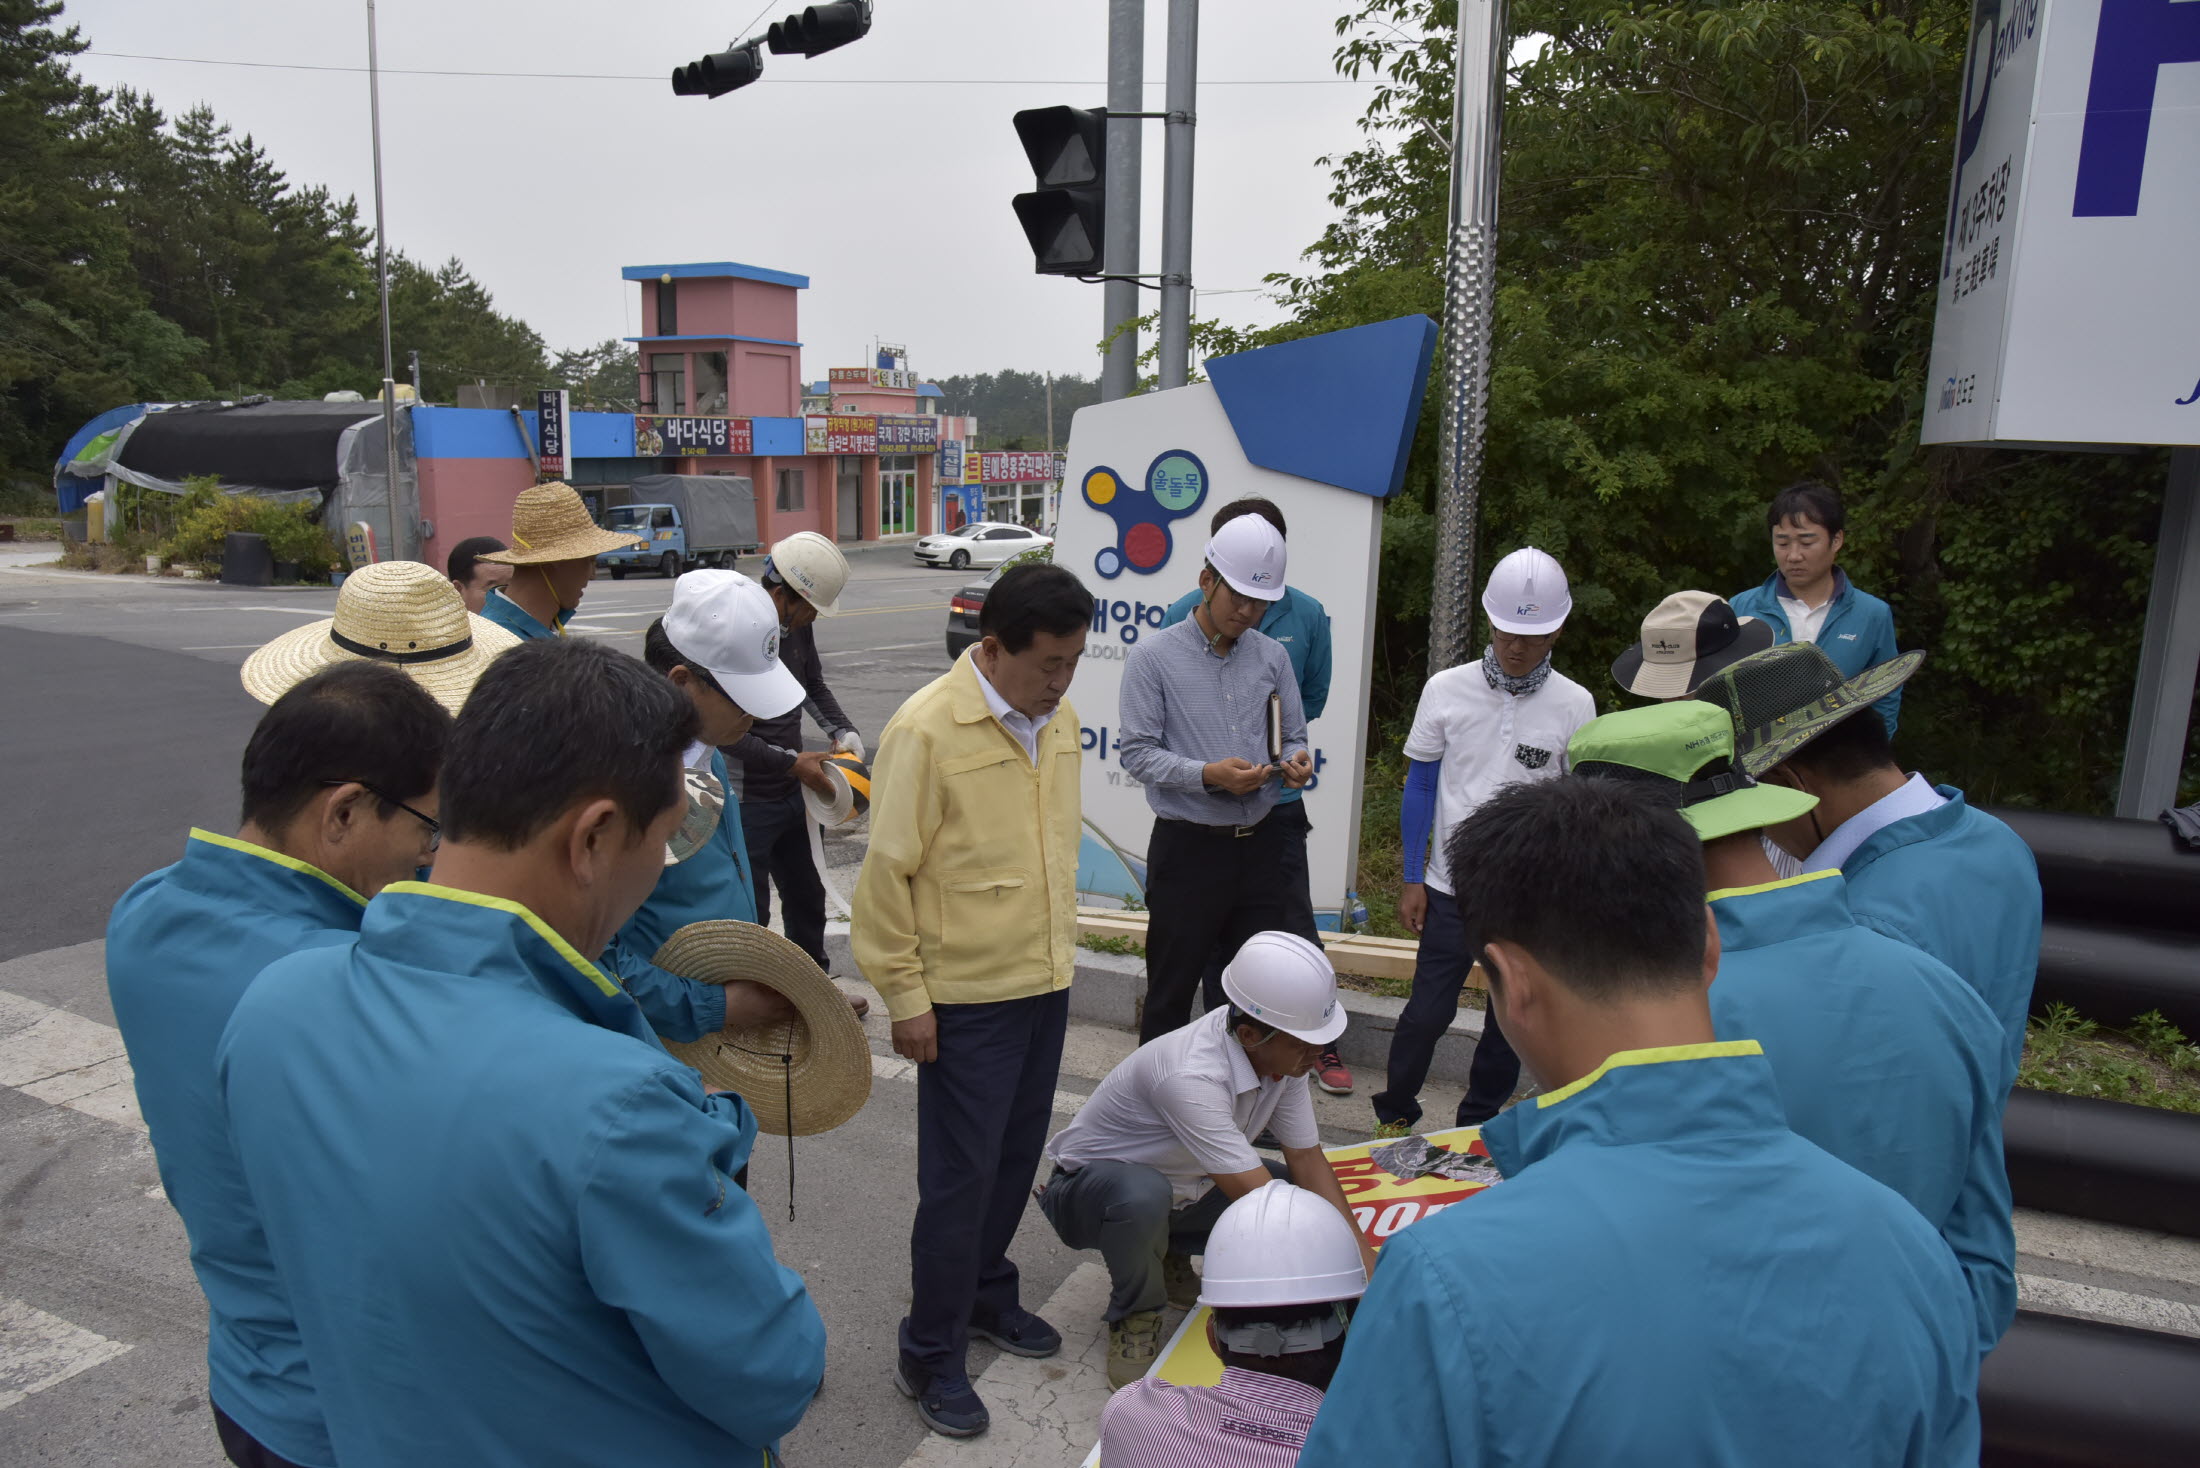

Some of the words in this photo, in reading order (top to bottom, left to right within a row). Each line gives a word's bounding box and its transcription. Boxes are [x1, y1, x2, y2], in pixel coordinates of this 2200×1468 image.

[1957, 153, 2012, 252] 제3주차장
[543, 392, 559, 455] 바다식당
[667, 418, 727, 446] 바다식당
[878, 426, 892, 443] 국제
[897, 427, 911, 443] 강판
[911, 427, 937, 444] 지붕공사
[828, 435, 849, 453] 슬라브
[850, 435, 876, 454] 지붕전문
[1153, 469, 1199, 498] 울돌목
[1223, 1418, 1236, 1430] LE
[1238, 1422, 1257, 1435] COQ
[1260, 1426, 1298, 1443] SPORTIF
